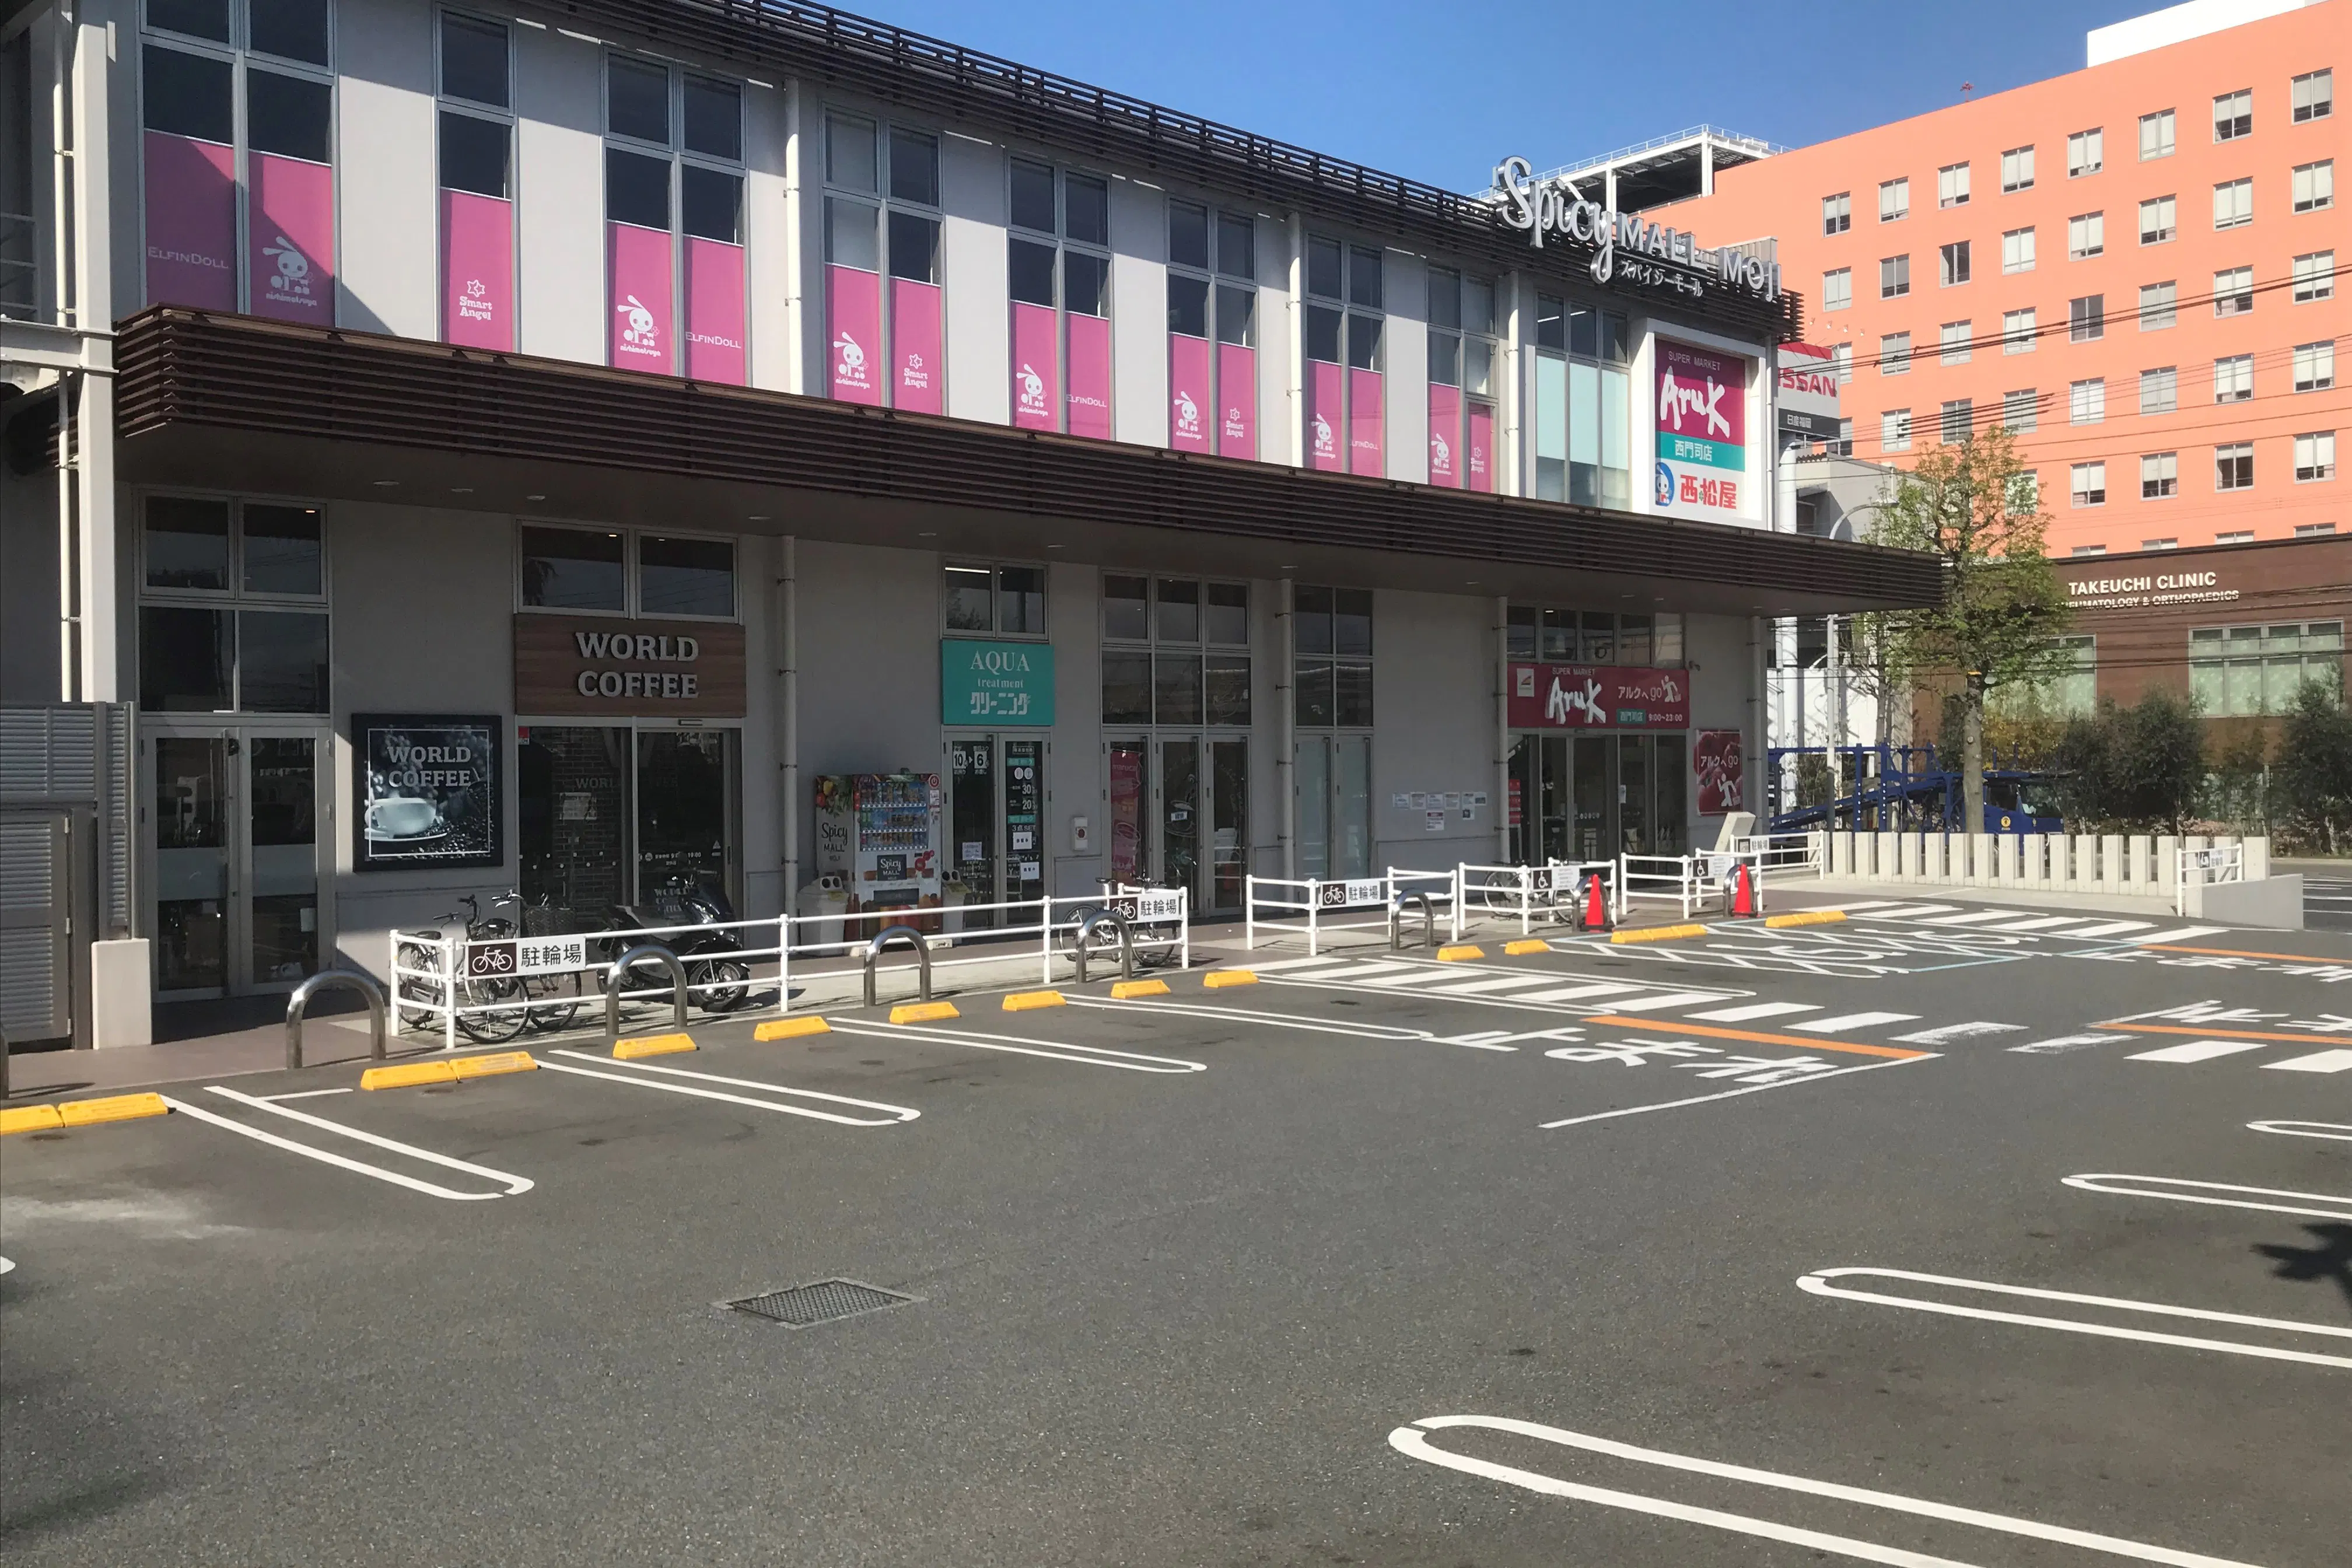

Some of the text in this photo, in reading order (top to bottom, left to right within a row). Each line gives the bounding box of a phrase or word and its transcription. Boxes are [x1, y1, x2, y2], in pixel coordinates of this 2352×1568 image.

[1497, 156, 1783, 303] Spicy MALL MOJI
[459, 295, 492, 310] Smart
[459, 306, 491, 320] Angel
[620, 342, 661, 357] nishimatsuya
[1668, 351, 1721, 372] SUPER MARKET
[904, 368, 928, 380] Smart
[904, 377, 928, 388] Angel
[1777, 368, 1837, 397] ISSAN
[1675, 439, 1713, 462] 西門司店
[1680, 474, 1737, 509] 西松屋
[2068, 571, 2217, 596] TAKEUCHI CLINIC
[575, 631, 699, 662] WORLD
[970, 650, 1030, 676] AQUA
[1552, 667, 1596, 676] SUPER MARKET
[578, 670, 698, 699] COFFEE
[978, 677, 1024, 688] treatment
[971, 691, 1031, 715] クリーニング
[387, 747, 471, 763] WORLD
[954, 754, 963, 766] 10
[977, 754, 984, 766] 6
[388, 771, 471, 787] COFFEE
[821, 822, 848, 845] Spicy
[824, 844, 845, 852] MALL
[880, 859, 901, 871] Spicy
[1349, 886, 1379, 900] 駐輪場
[1140, 899, 1178, 916] 駐輪場
[521, 944, 582, 967] 駐輪場
